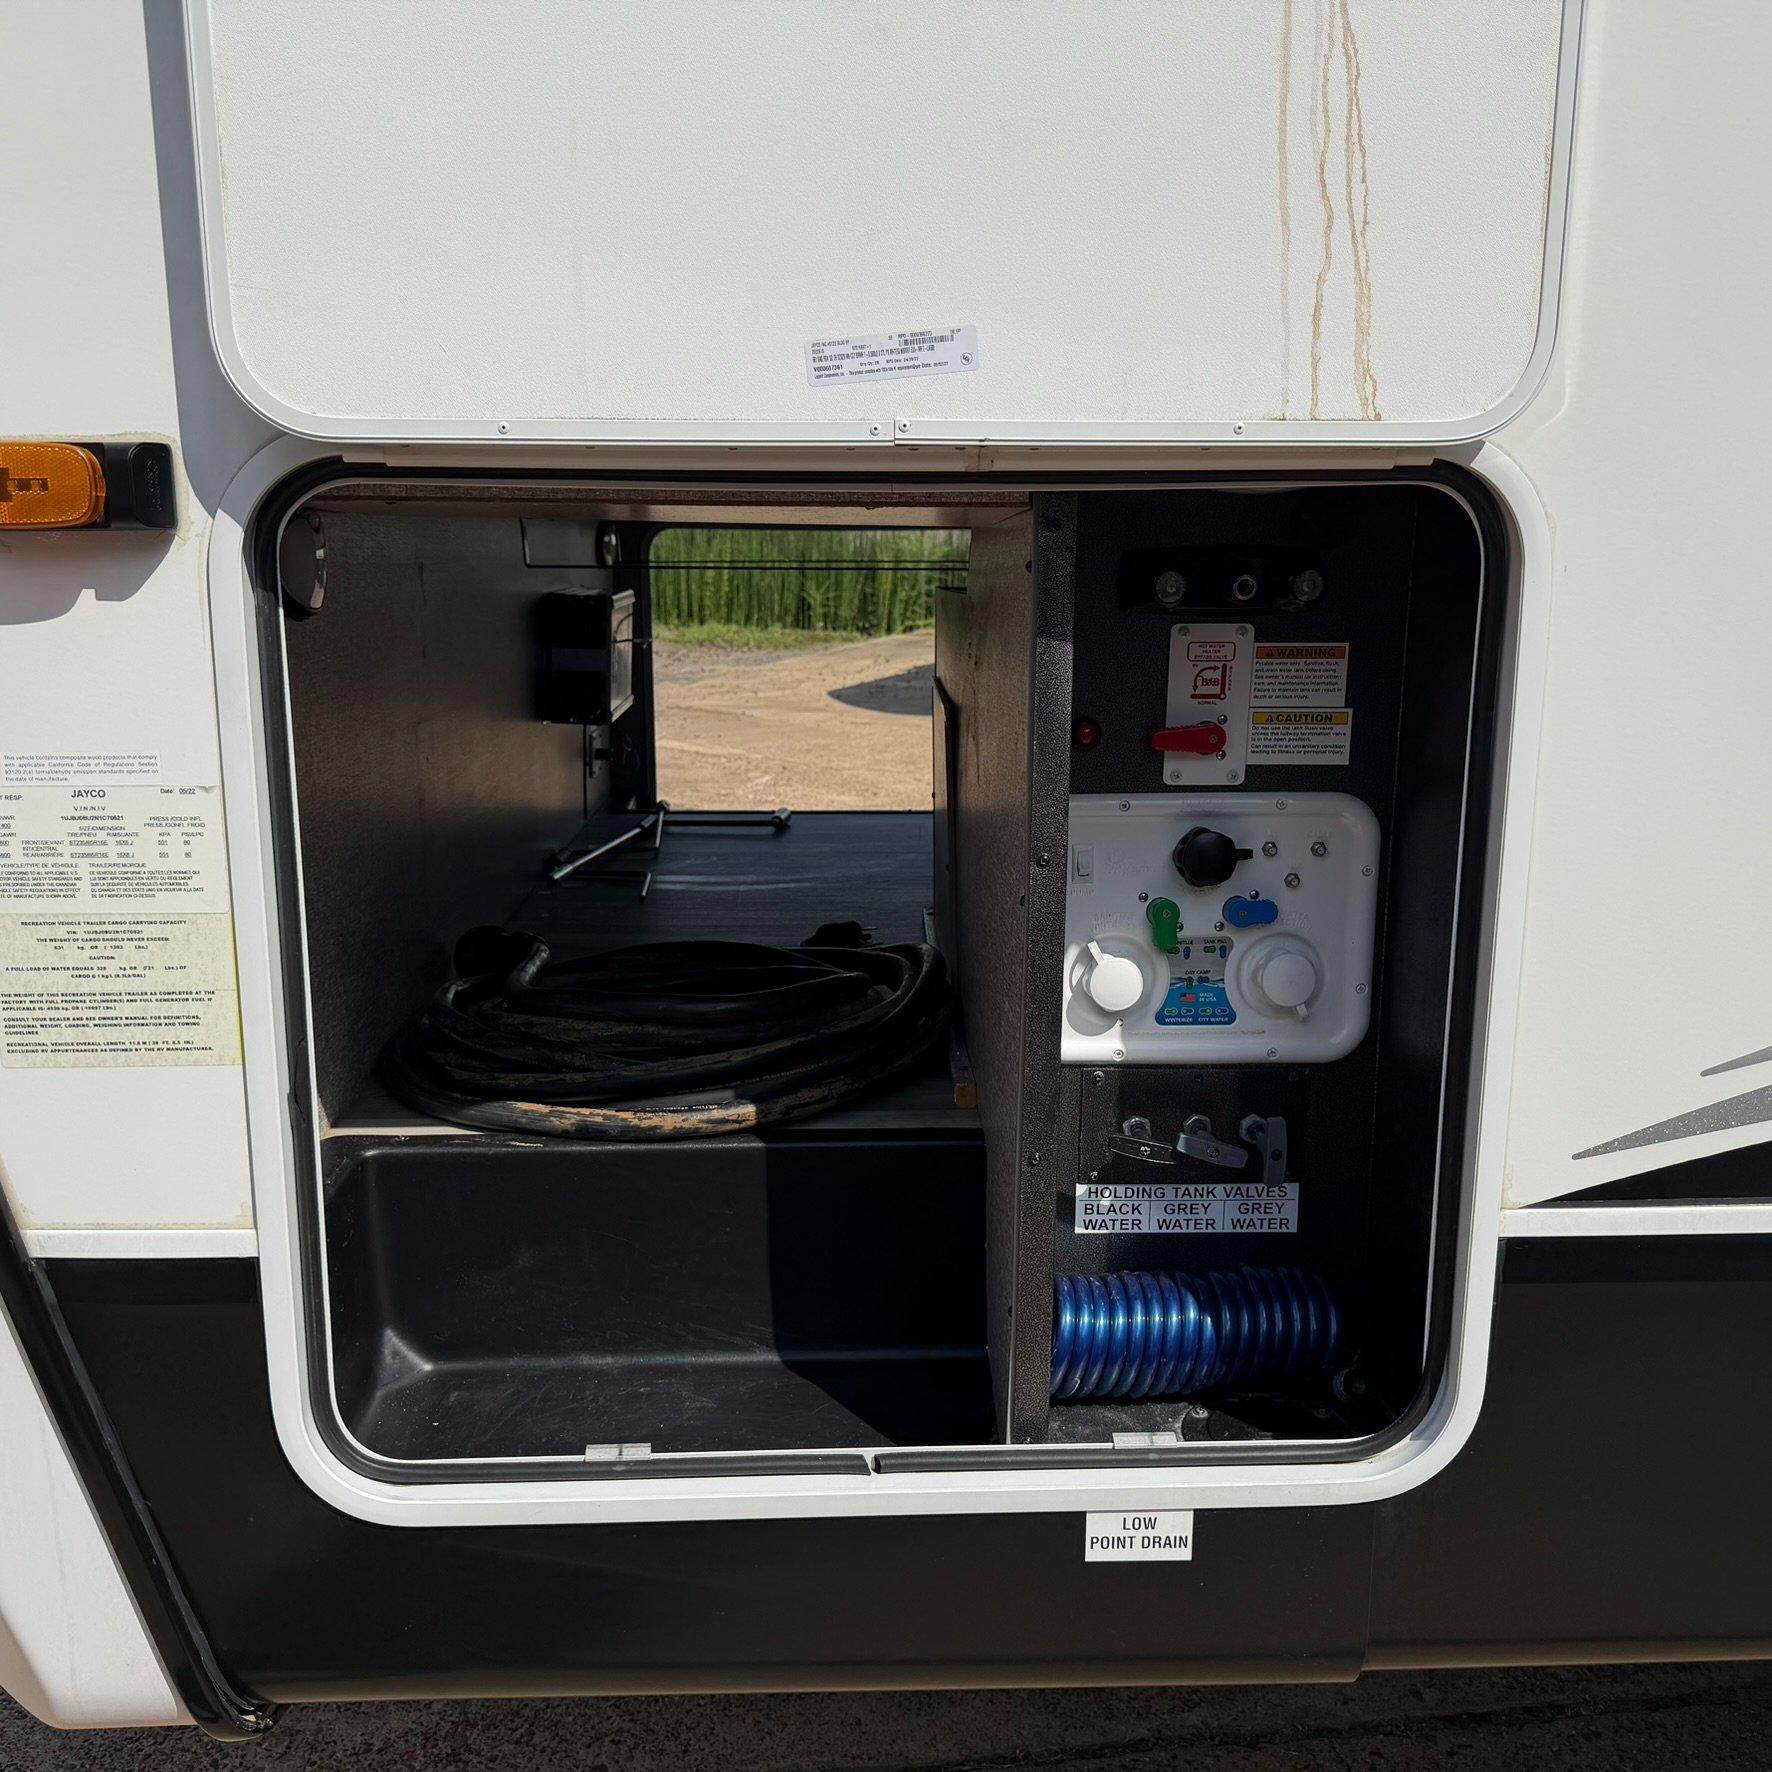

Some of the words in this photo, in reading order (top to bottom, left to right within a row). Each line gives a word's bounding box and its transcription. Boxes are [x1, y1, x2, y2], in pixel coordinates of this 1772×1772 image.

[1277, 648, 1336, 657] WARNING
[1276, 714, 1333, 723] CAUTION
[71, 789, 106, 798] JAYCO
[1088, 1186, 1166, 1199] HOLDING
[1172, 1186, 1217, 1198] TANK
[1223, 1186, 1288, 1198] VALVES
[1084, 1203, 1143, 1215] BLACK
[1163, 1202, 1211, 1215] GREY
[1238, 1202, 1285, 1214] GREY
[1083, 1219, 1142, 1230] WATER
[1157, 1218, 1216, 1230] WATER
[1230, 1218, 1290, 1230] WATER
[1123, 1517, 1157, 1530] LOW
[1090, 1536, 1136, 1549] POINT
[1141, 1535, 1188, 1549] DRAIN
